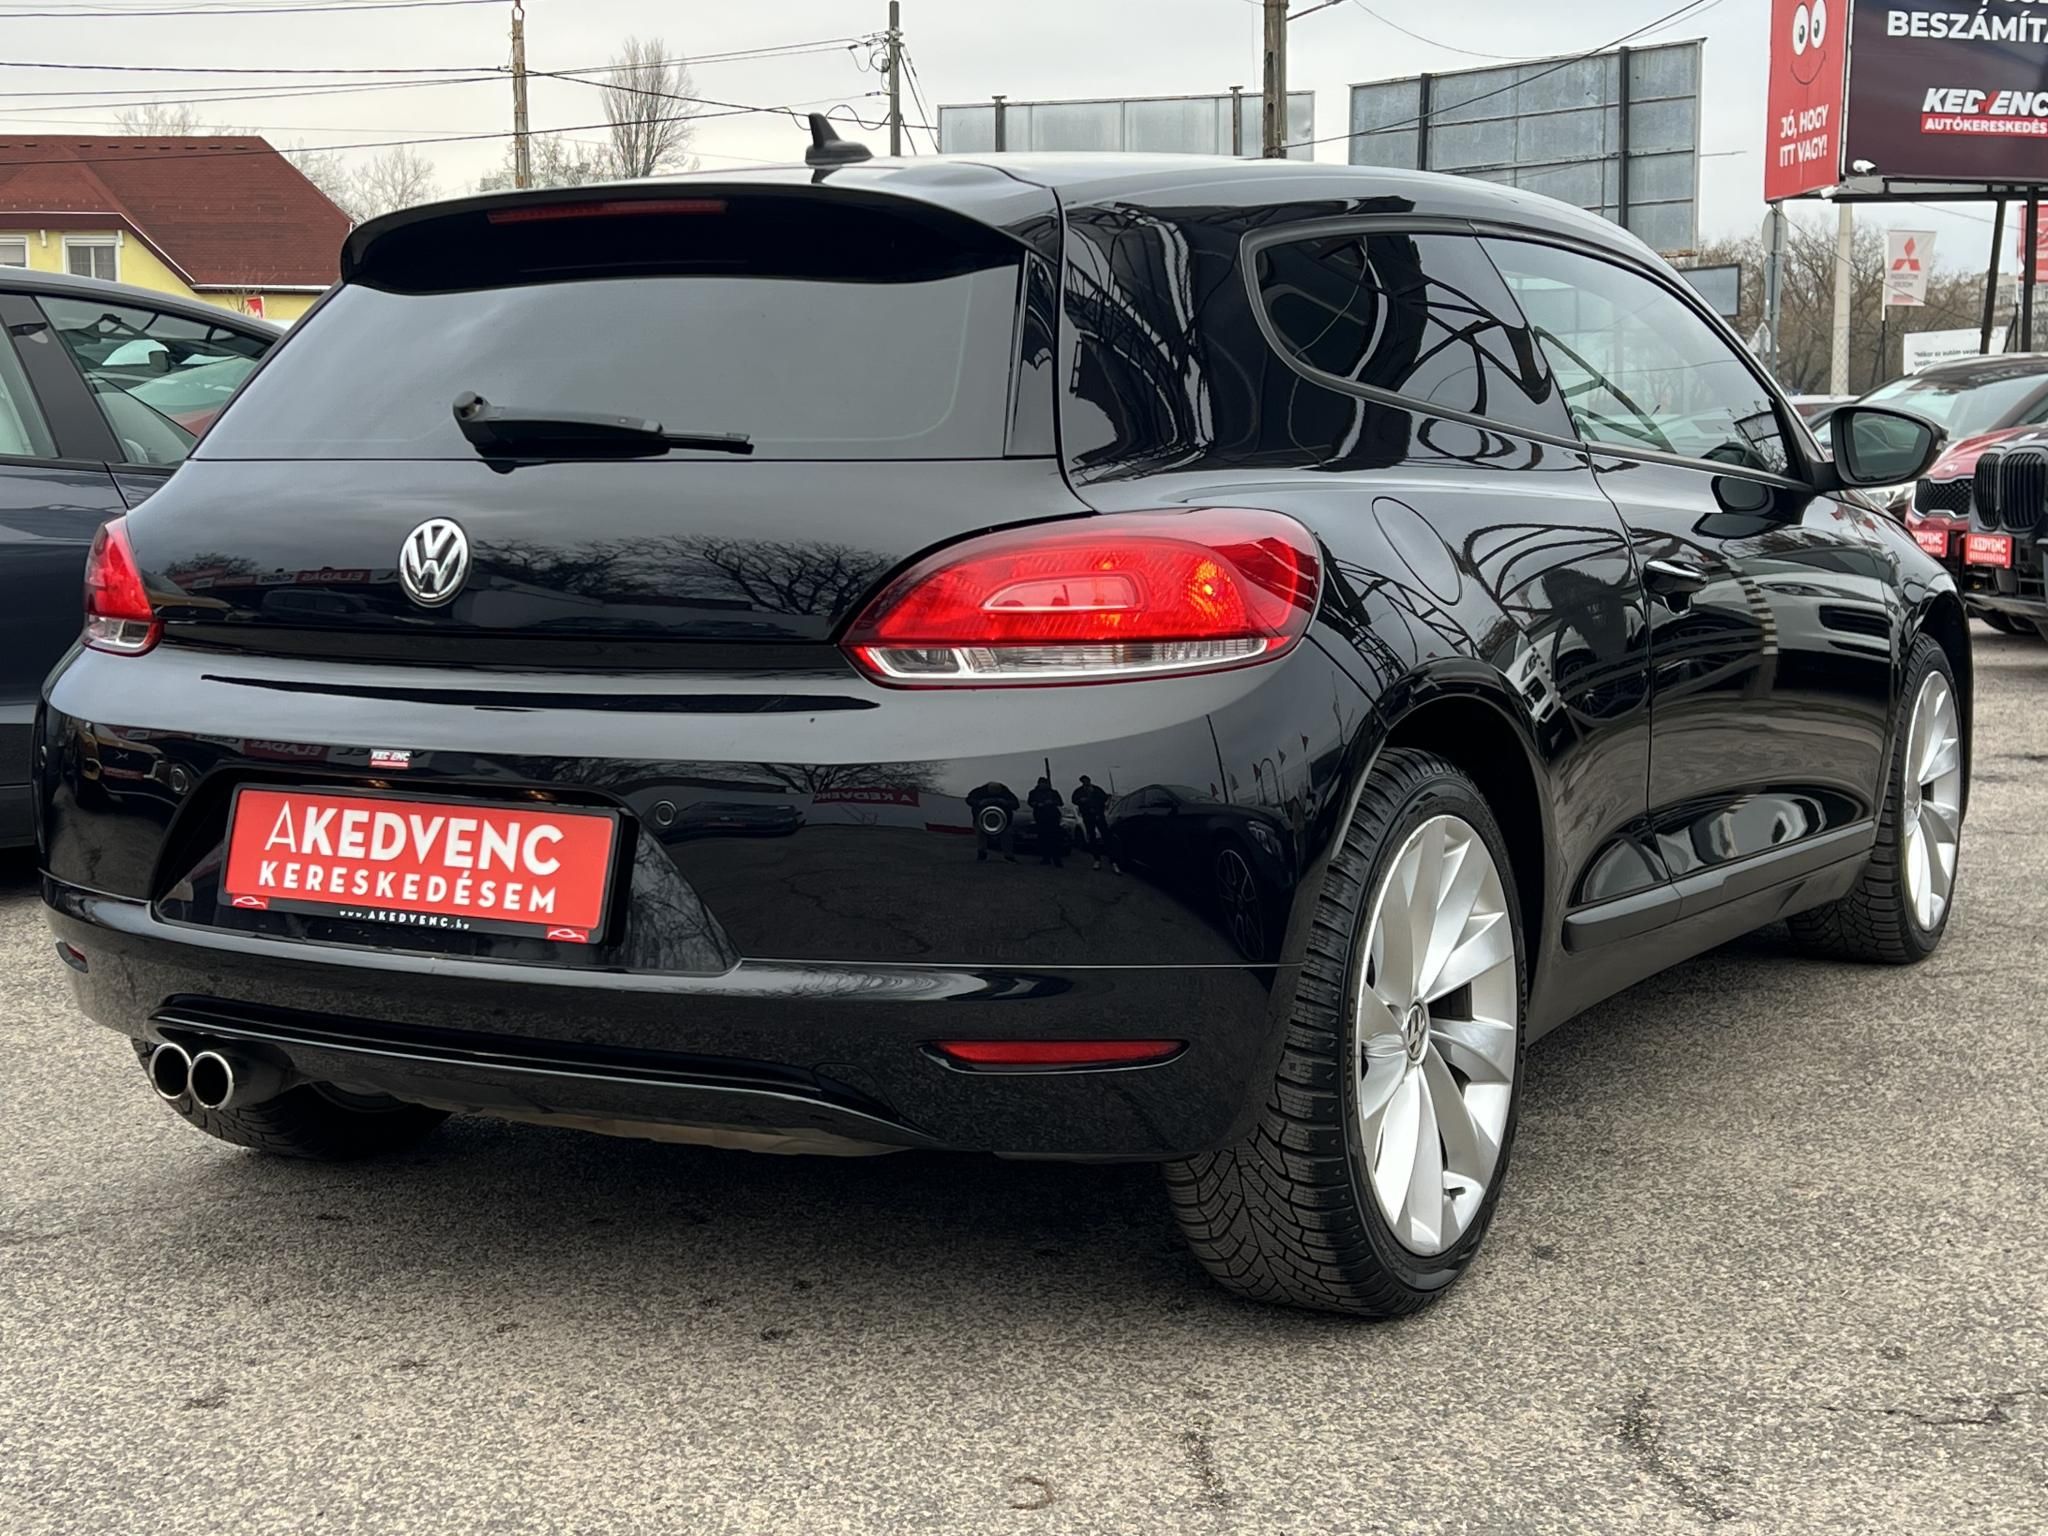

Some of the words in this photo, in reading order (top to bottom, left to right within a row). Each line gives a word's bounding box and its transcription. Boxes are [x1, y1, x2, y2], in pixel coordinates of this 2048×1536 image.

[1780, 108, 1798, 139] JÓ,
[1799, 103, 1829, 133] HOGY
[1924, 116, 2048, 134] AUTÓKERESKEDÉS
[1779, 143, 1796, 168] ITT
[1797, 134, 1828, 163] VAGY!
[264, 800, 564, 876] AKEDVENC
[258, 860, 556, 914] KERESKEDÉSEM
[339, 910, 470, 930] www.AKEDVENC.hu
